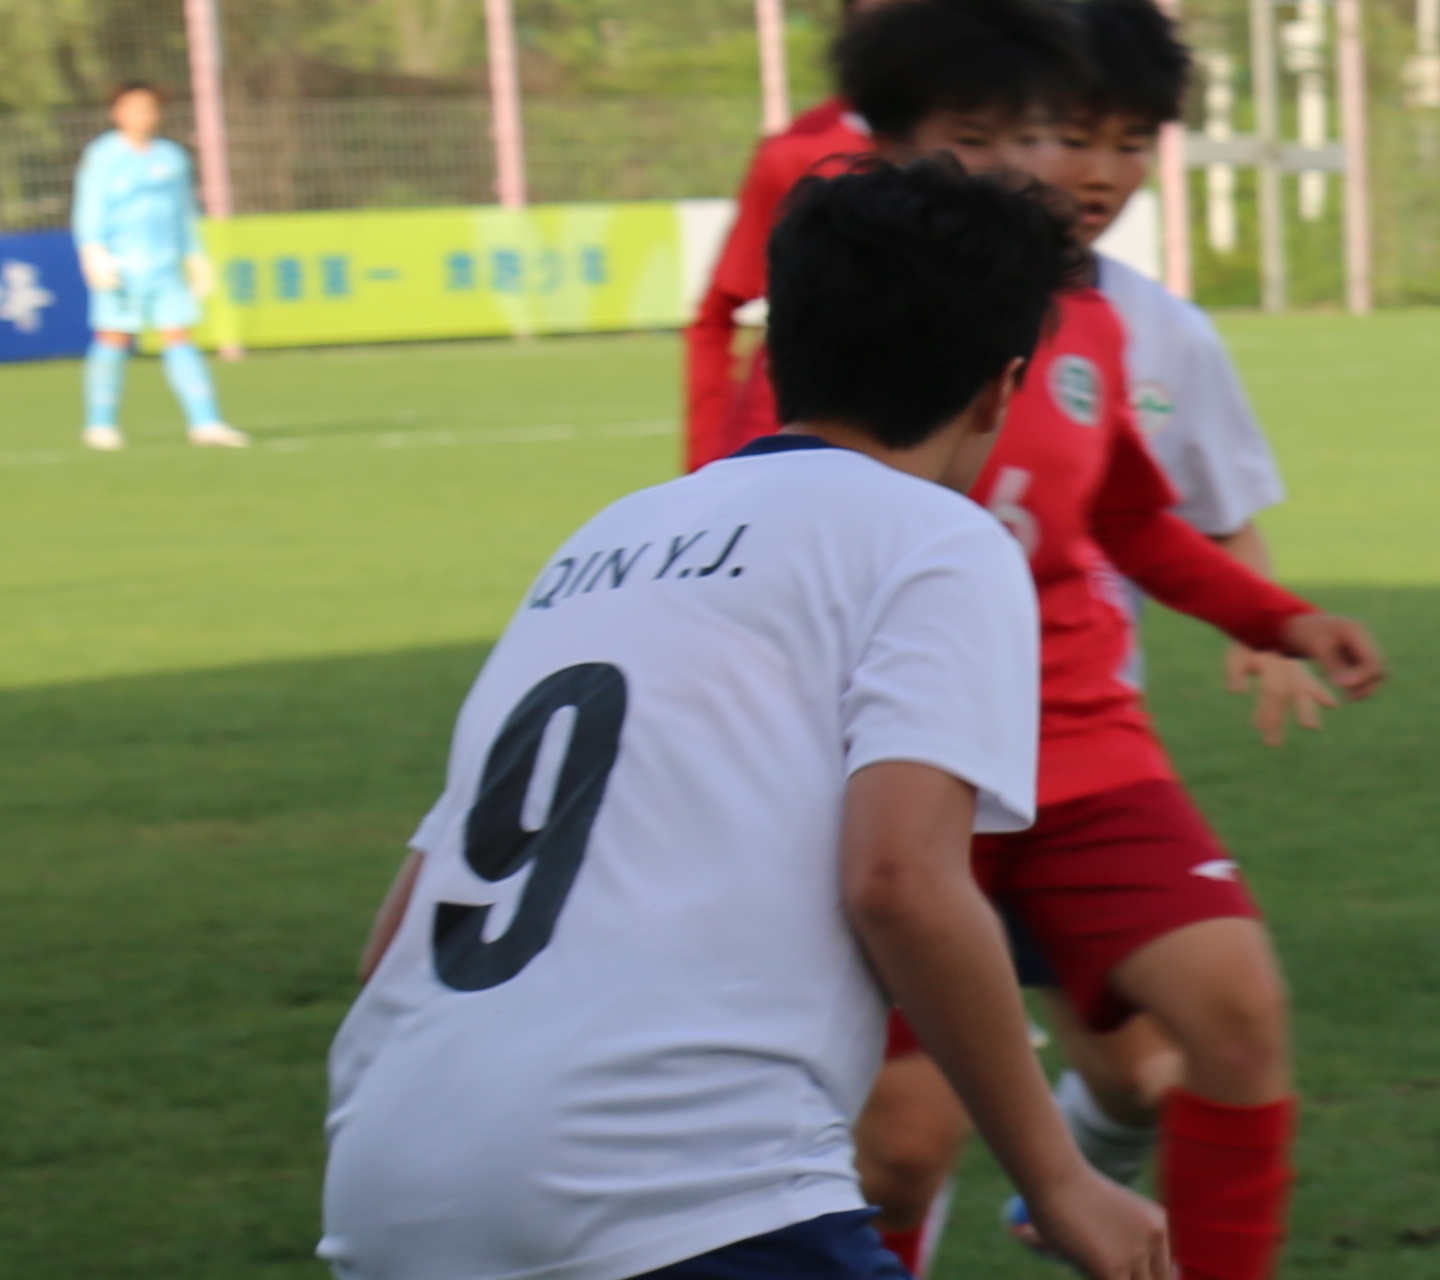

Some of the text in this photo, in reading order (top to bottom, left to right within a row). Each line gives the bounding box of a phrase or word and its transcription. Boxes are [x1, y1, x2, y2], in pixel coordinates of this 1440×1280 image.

[529, 522, 751, 609] QIN Y.J.
[431, 661, 628, 992] 9
